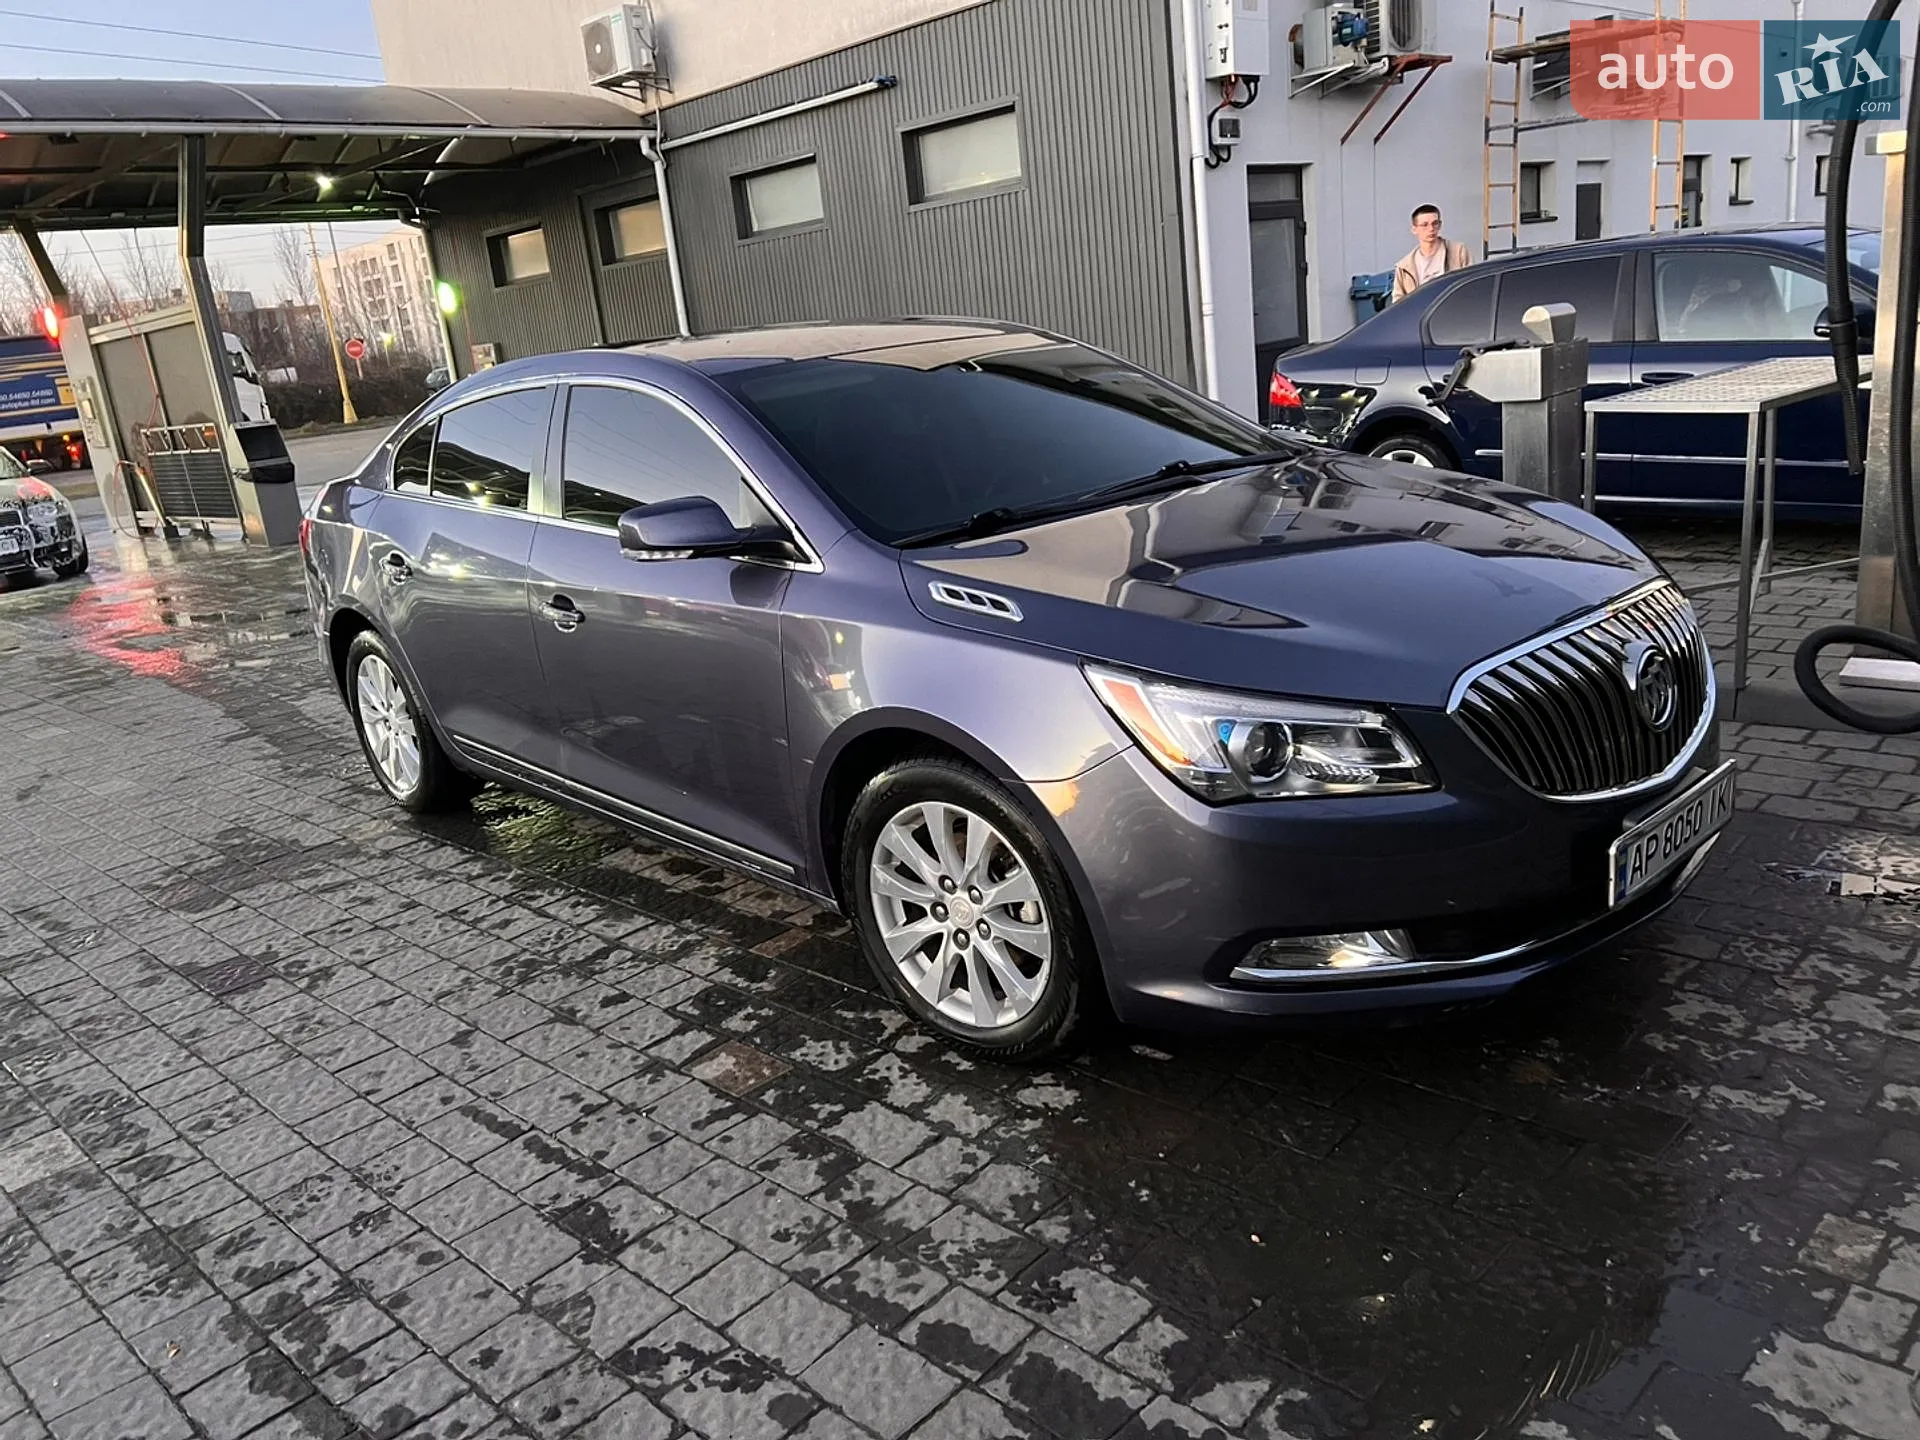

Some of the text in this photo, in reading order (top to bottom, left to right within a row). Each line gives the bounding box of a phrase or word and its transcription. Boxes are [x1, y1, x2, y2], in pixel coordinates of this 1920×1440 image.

[1628, 776, 1728, 885] AP 8050 IK
